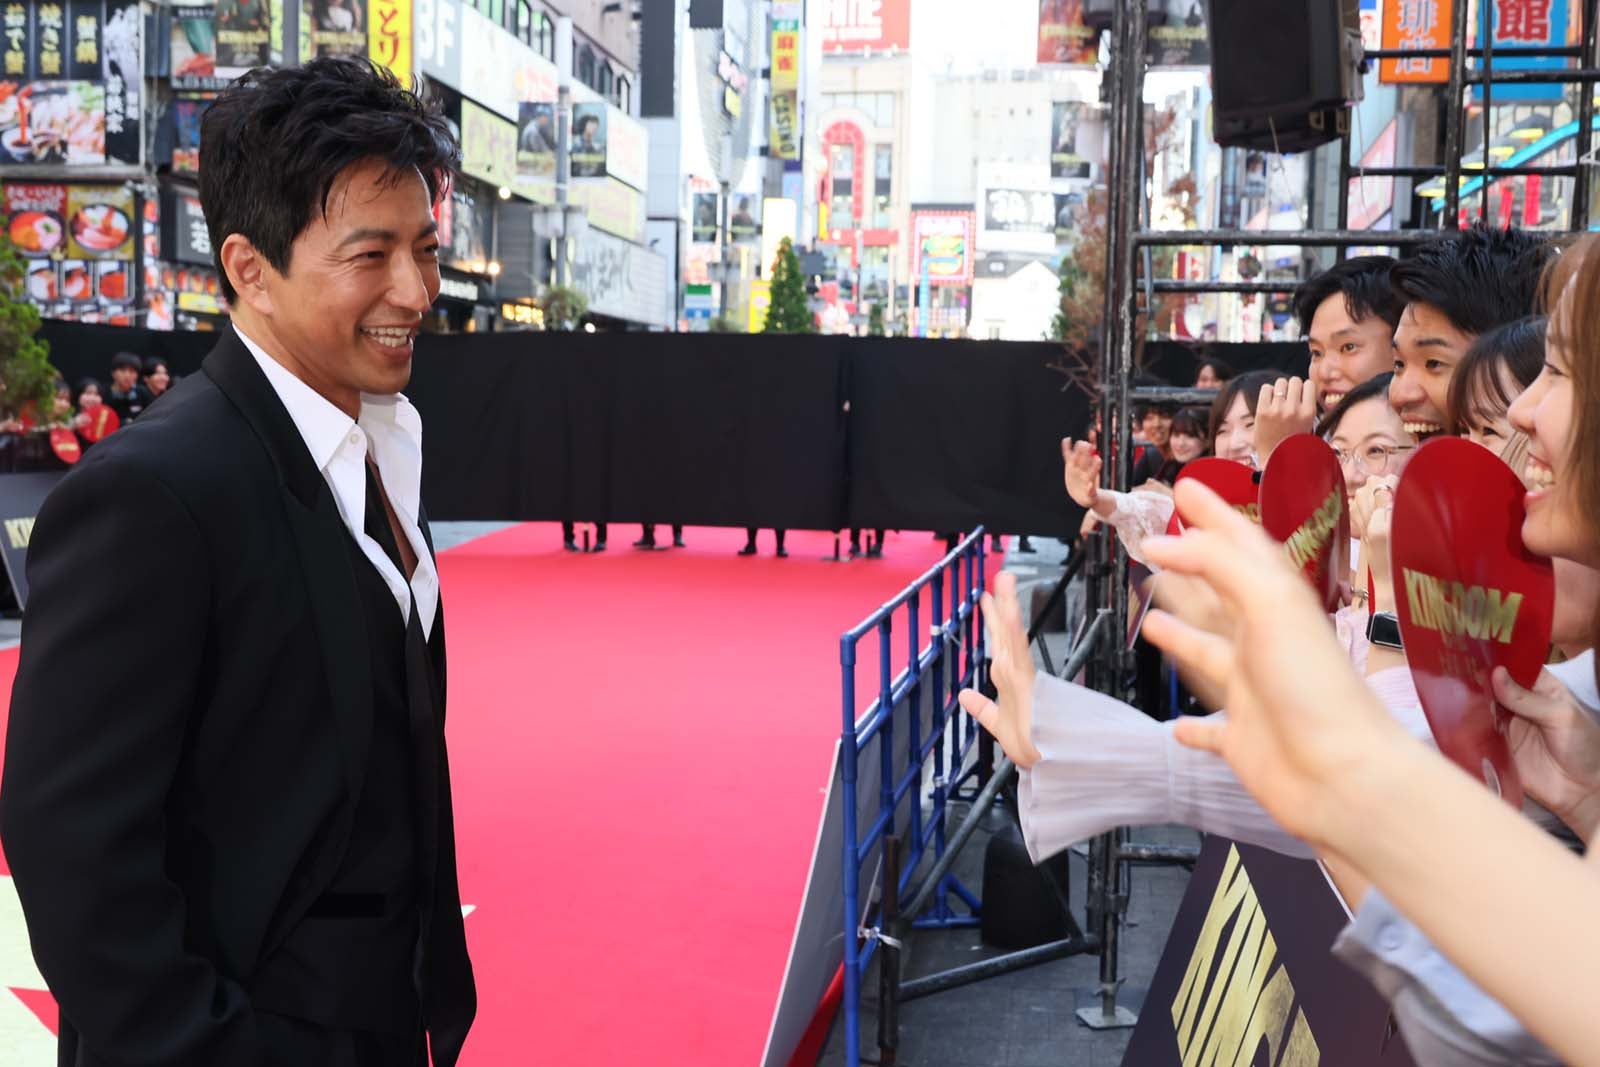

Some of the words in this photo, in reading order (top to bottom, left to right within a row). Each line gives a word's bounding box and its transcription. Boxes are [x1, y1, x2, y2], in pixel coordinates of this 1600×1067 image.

[1495, 0, 1550, 42] 館
[773, 94, 796, 153] CASINO
[1402, 566, 1525, 644] KINGDOM
